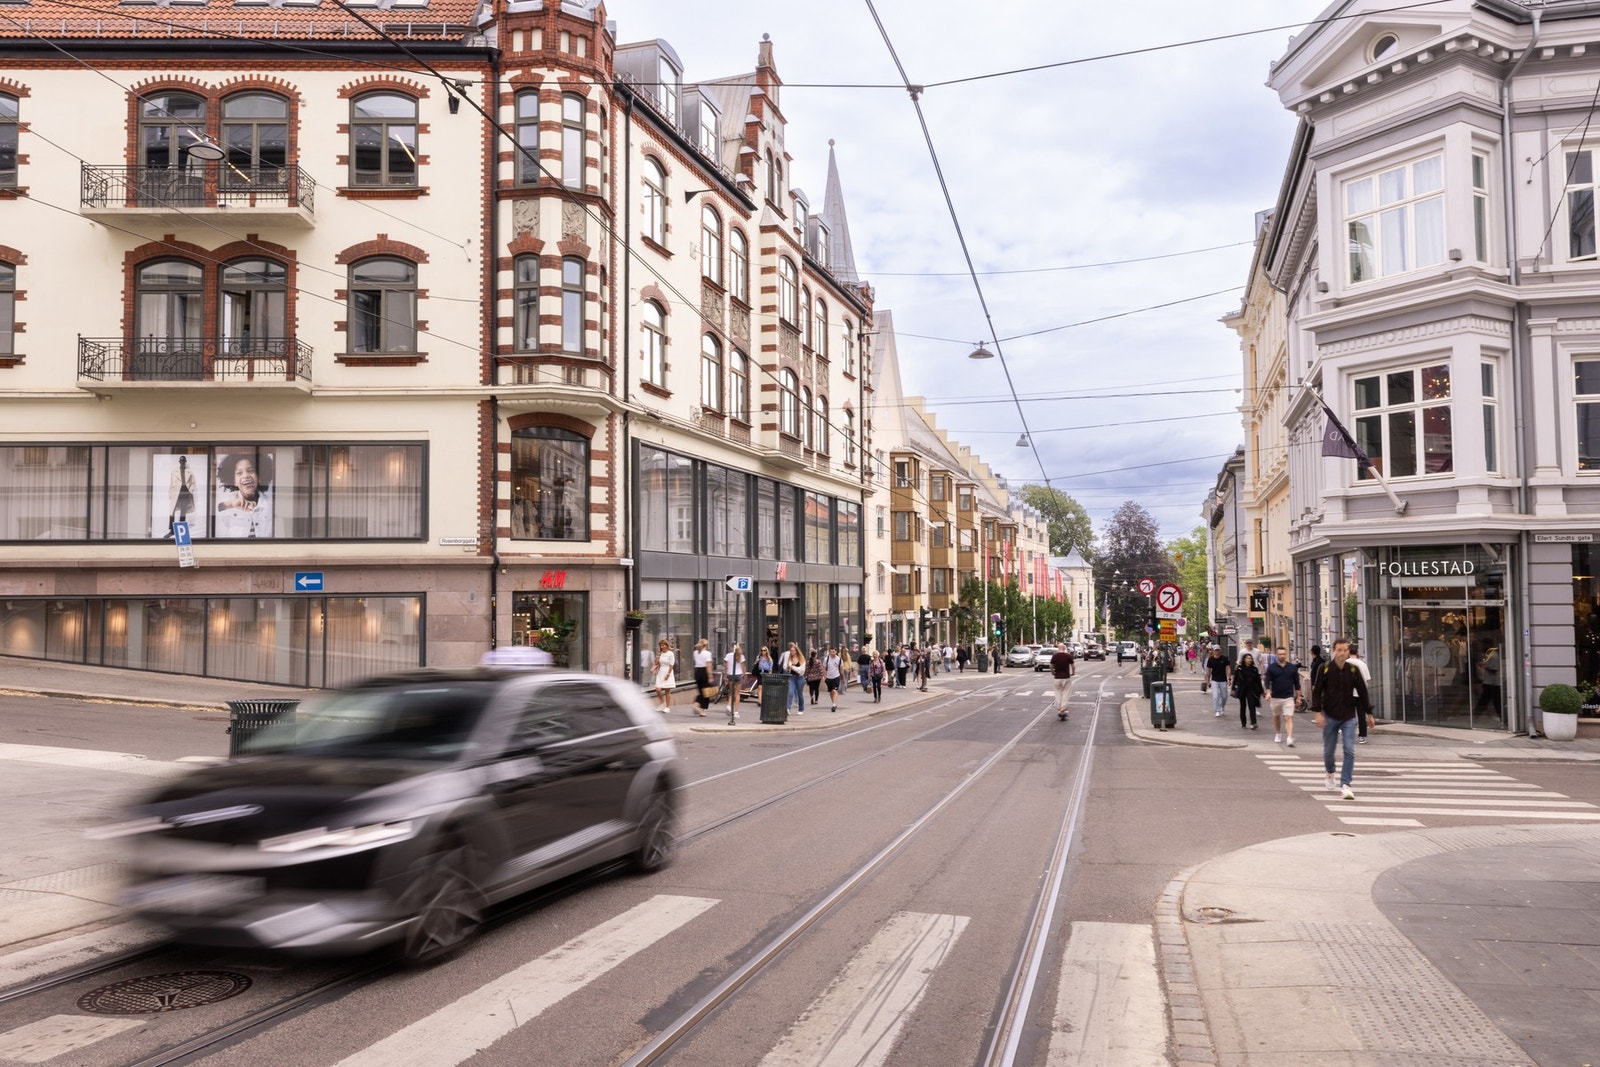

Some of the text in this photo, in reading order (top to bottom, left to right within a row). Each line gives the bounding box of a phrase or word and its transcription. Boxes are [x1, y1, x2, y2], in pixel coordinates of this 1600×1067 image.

[177, 525, 186, 543] P
[1379, 560, 1475, 576] FOLLESTAD
[1254, 598, 1265, 610] K
